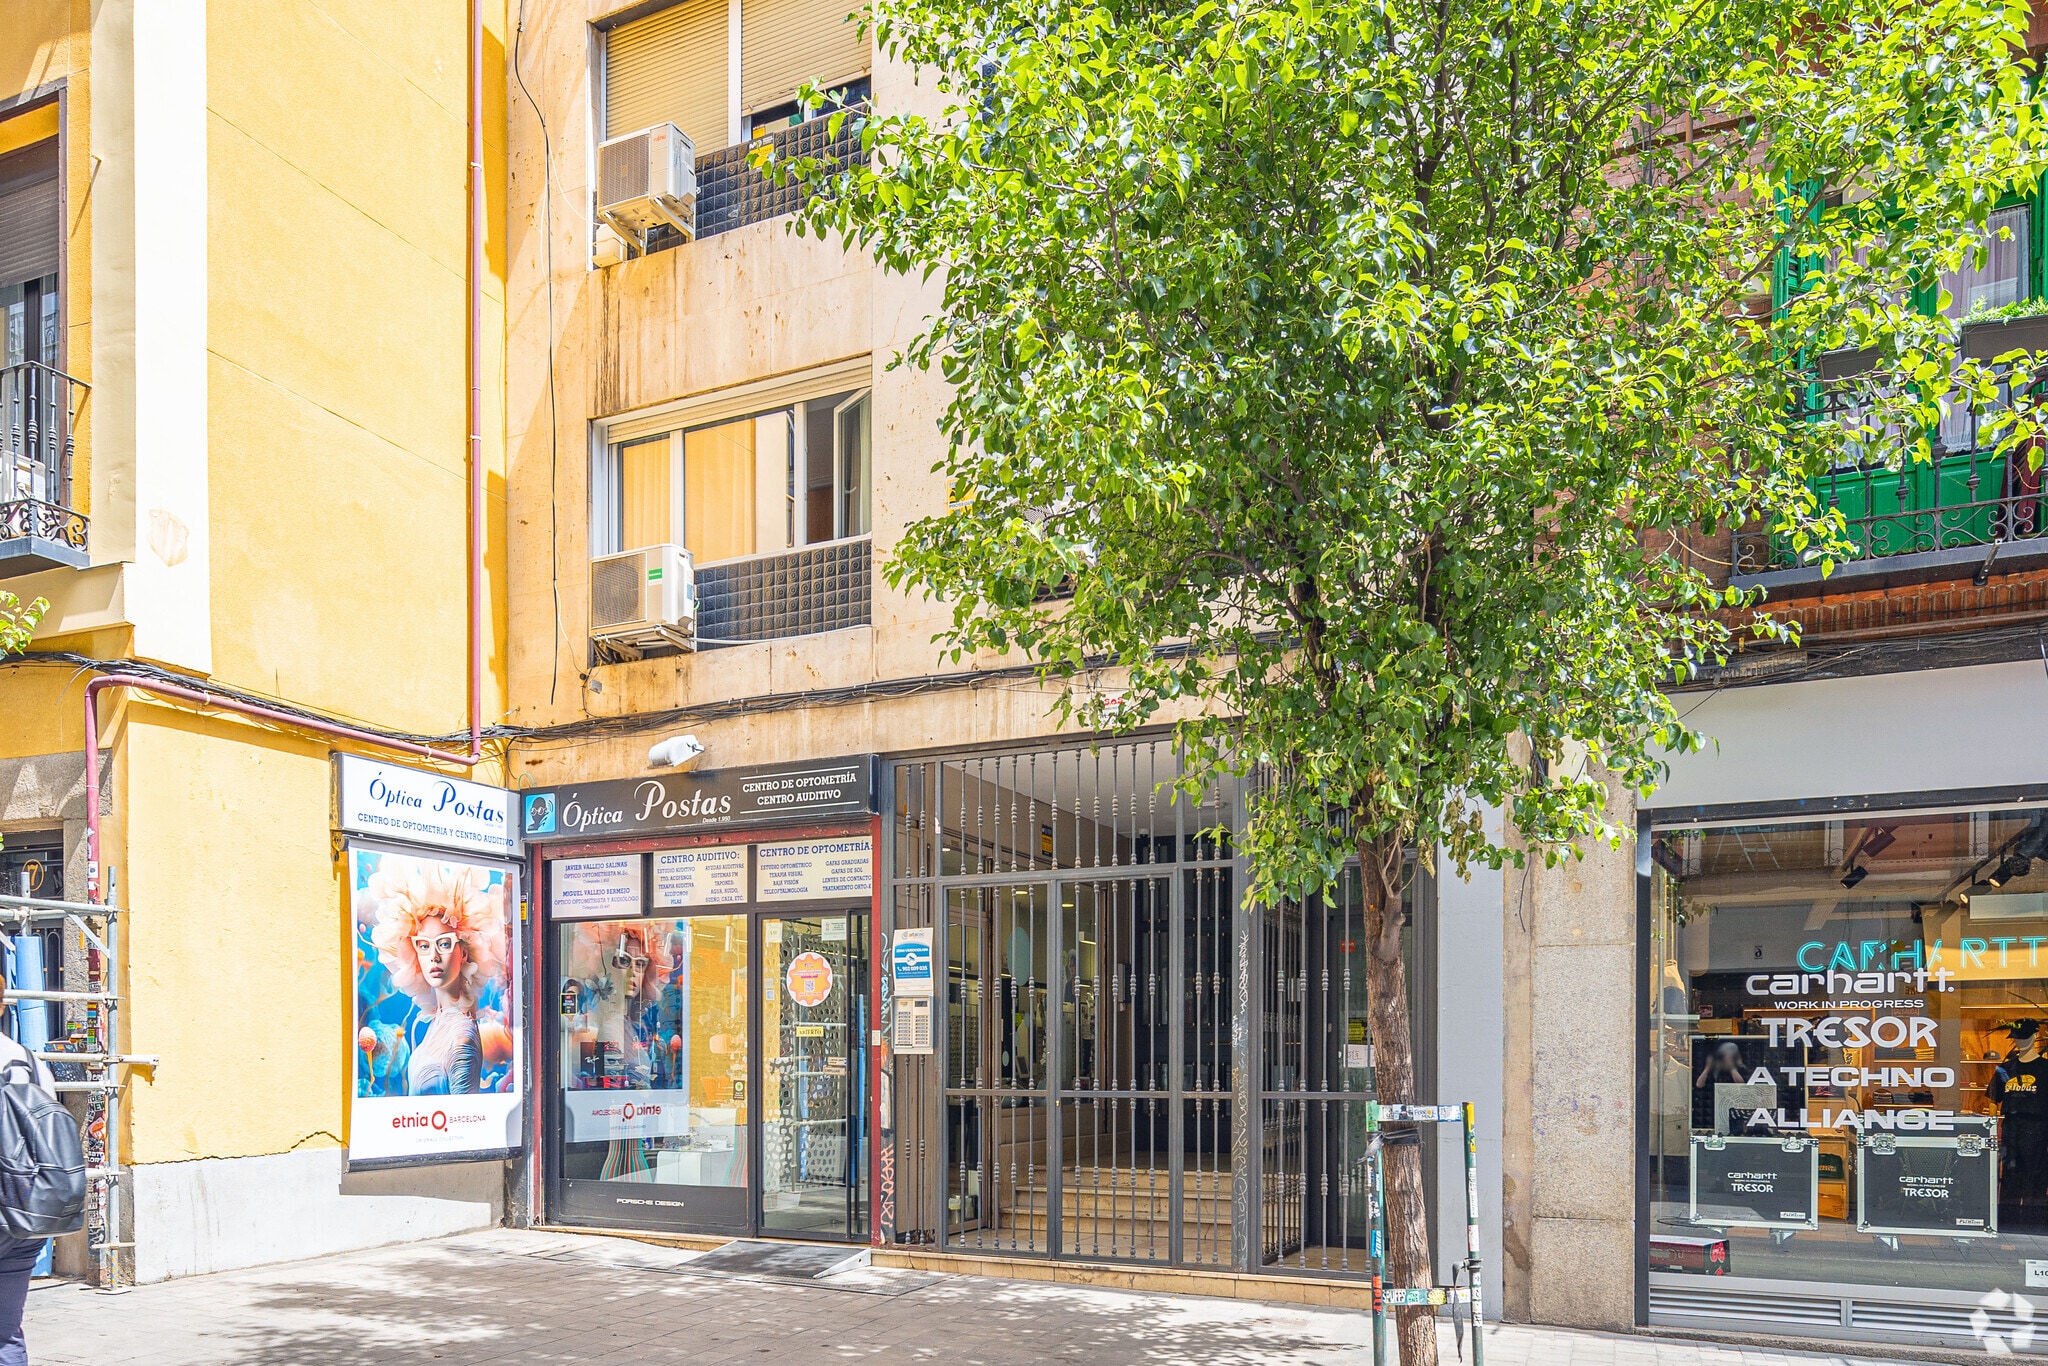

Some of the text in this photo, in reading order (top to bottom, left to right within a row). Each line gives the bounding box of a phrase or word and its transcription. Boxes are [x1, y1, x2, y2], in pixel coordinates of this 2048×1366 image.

[742, 771, 857, 793] CENTRO DE OPTOMETRÍA
[369, 771, 505, 824] Óptica Postas
[562, 780, 732, 833] Óptica Postas
[757, 789, 841, 806] CENTRO AUDITIVO
[357, 812, 390, 826] CENTRO
[390, 818, 401, 828] DE
[449, 828, 455, 837] Y
[455, 829, 483, 842] CENTRO
[483, 834, 515, 848] AUDITIVO
[660, 851, 740, 864] CENTRO AUDITIVO:
[760, 847, 795, 858] CENTRO
[797, 846, 809, 855] DE
[27, 864, 39, 887] 7
[565, 861, 628, 872] JAVIER VALLEJO SALINAS
[1774, 999, 1924, 1010] WORK IN PROGRESS
[1761, 1016, 1938, 1049] TRESOR
[1746, 1066, 1955, 1088] A TECHNO
[392, 1111, 486, 1129] etnia BARCELONA
[1746, 1107, 1955, 1131] ALLIANCE
[1730, 1183, 1774, 1193] TRESOR
[1902, 1187, 1950, 1198] TRESOR
[616, 1198, 685, 1208] PORSCHE DESIGN
